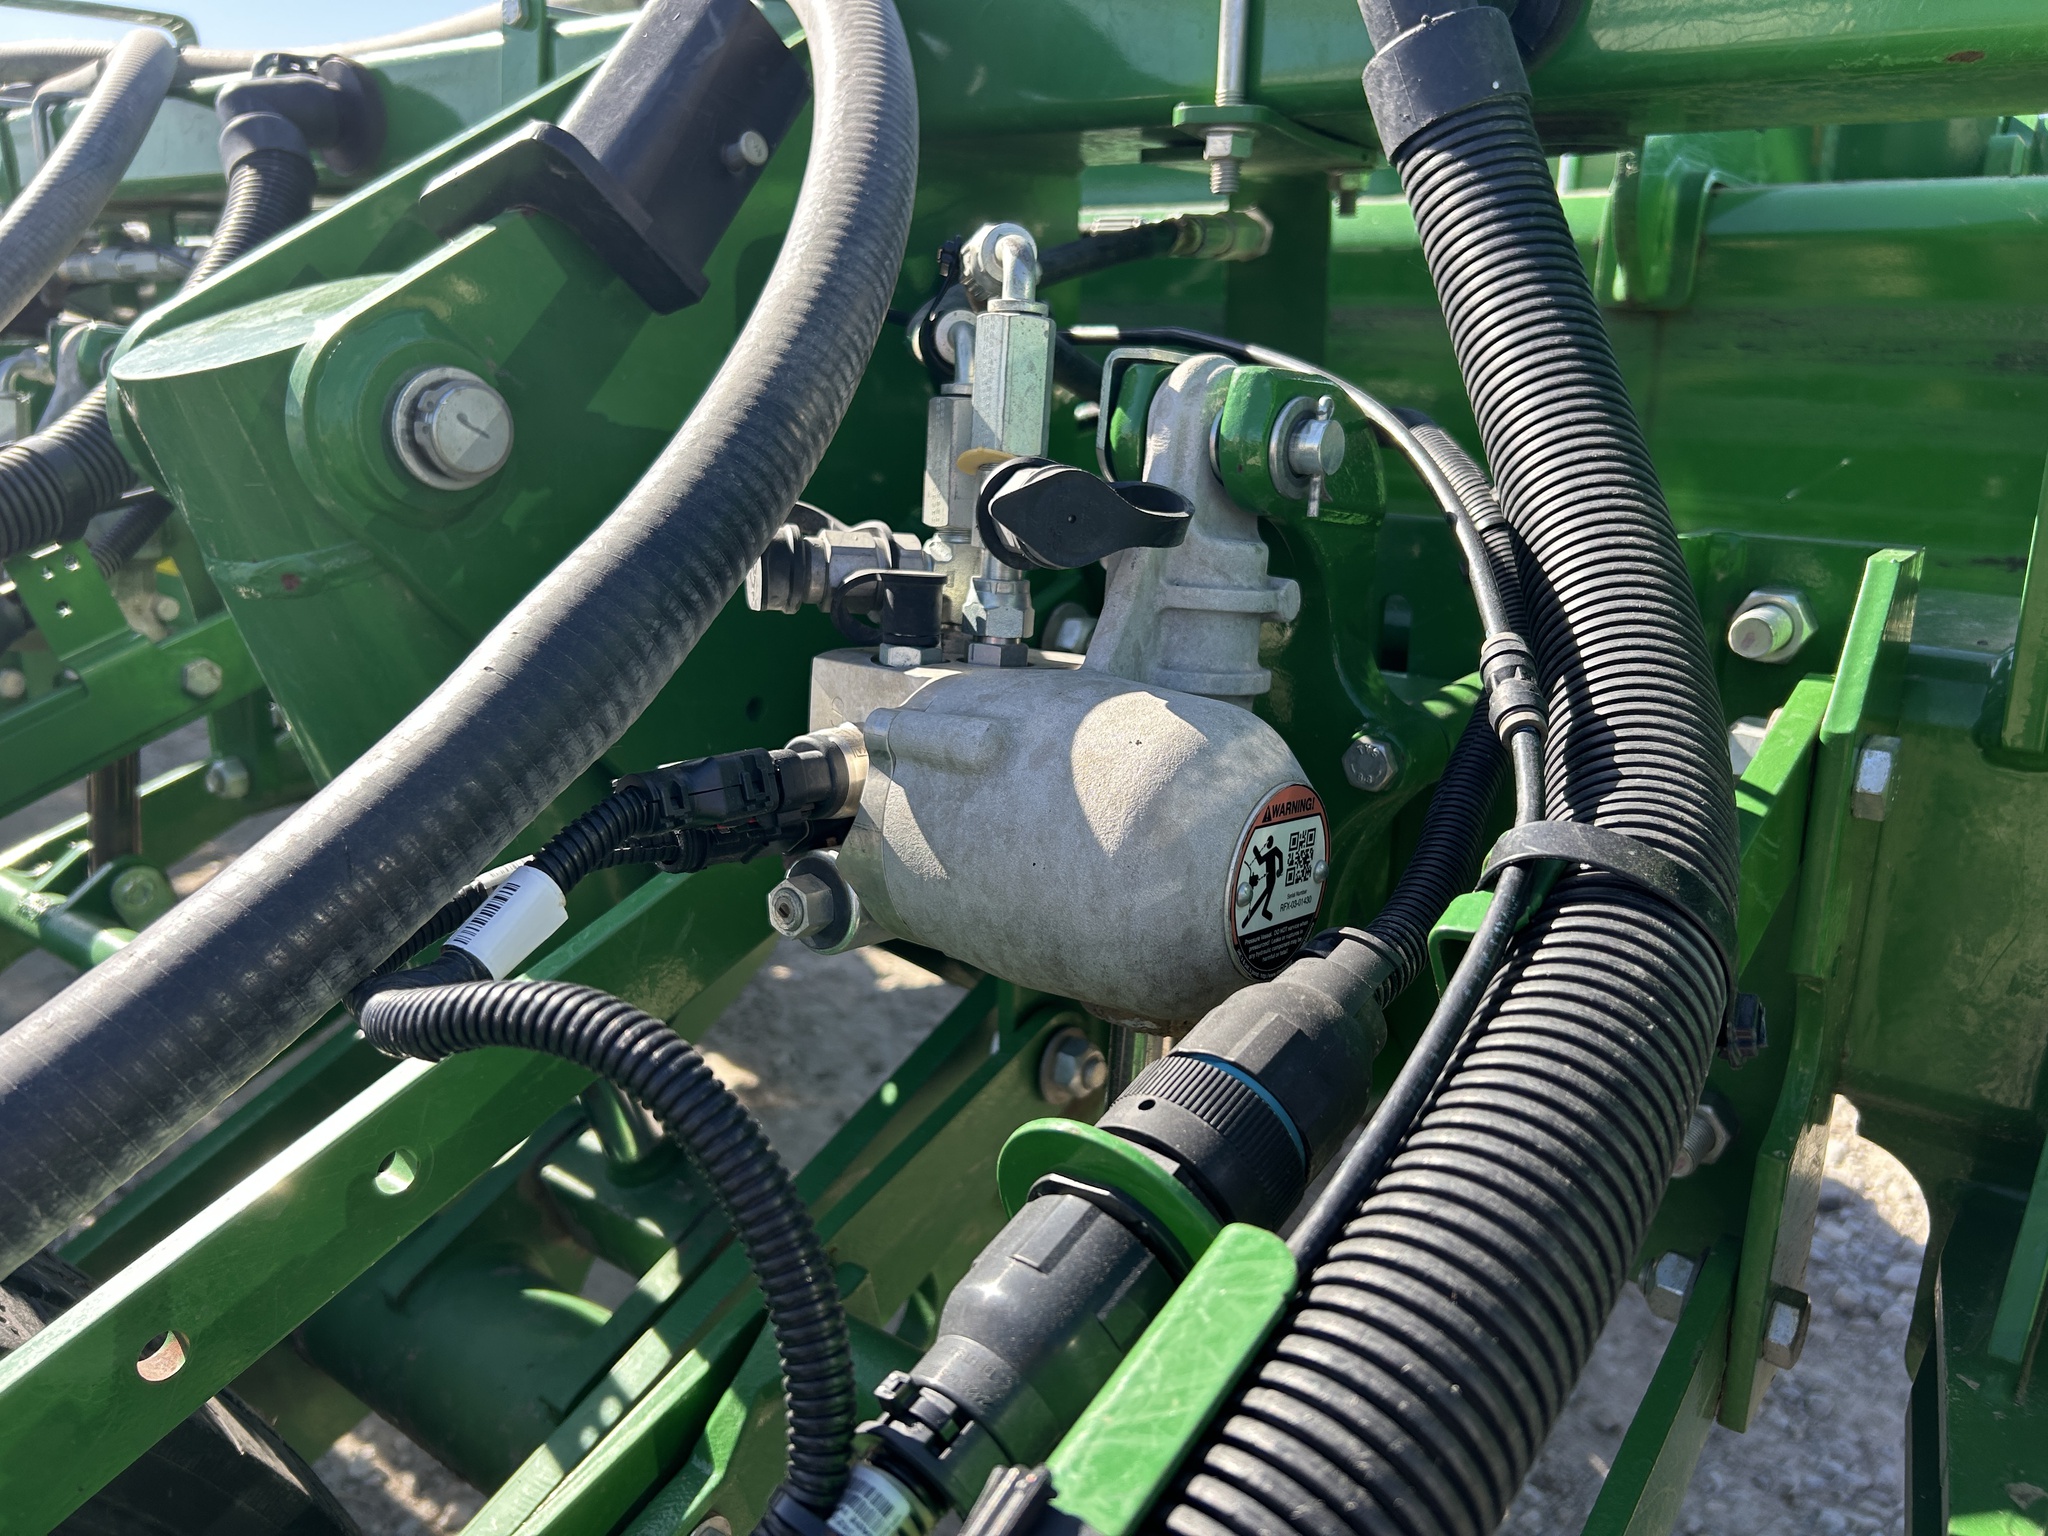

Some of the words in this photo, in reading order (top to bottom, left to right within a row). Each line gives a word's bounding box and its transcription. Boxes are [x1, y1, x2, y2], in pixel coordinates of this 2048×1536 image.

[1272, 797, 1316, 818] WARNING!
[1287, 892, 1296, 900] Serial
[1244, 936, 1261, 945] Pressure
[1280, 926, 1288, 934] NOT
[1288, 923, 1299, 931] service
[1299, 920, 1309, 928] when
[1255, 947, 1272, 957] hydraulic
